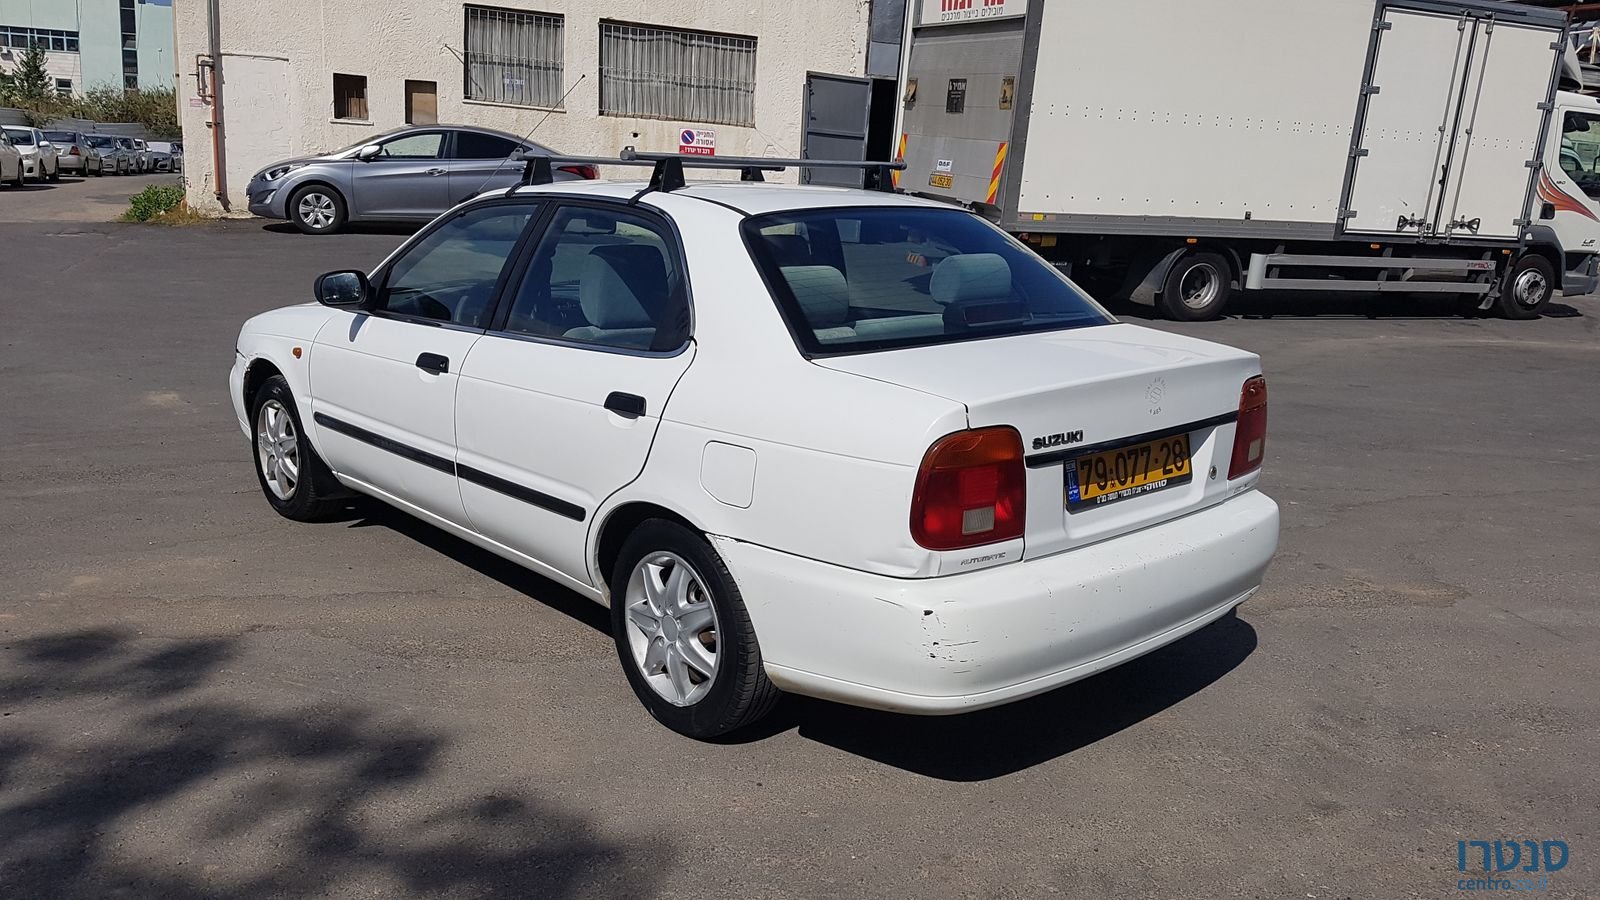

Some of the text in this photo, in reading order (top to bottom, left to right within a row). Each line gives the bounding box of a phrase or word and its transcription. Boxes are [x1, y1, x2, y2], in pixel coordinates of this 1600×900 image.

[696, 138, 714, 146] אסורה
[1032, 430, 1084, 450] SUZUKI
[960, 552, 1006, 566] AUTOMATIC
